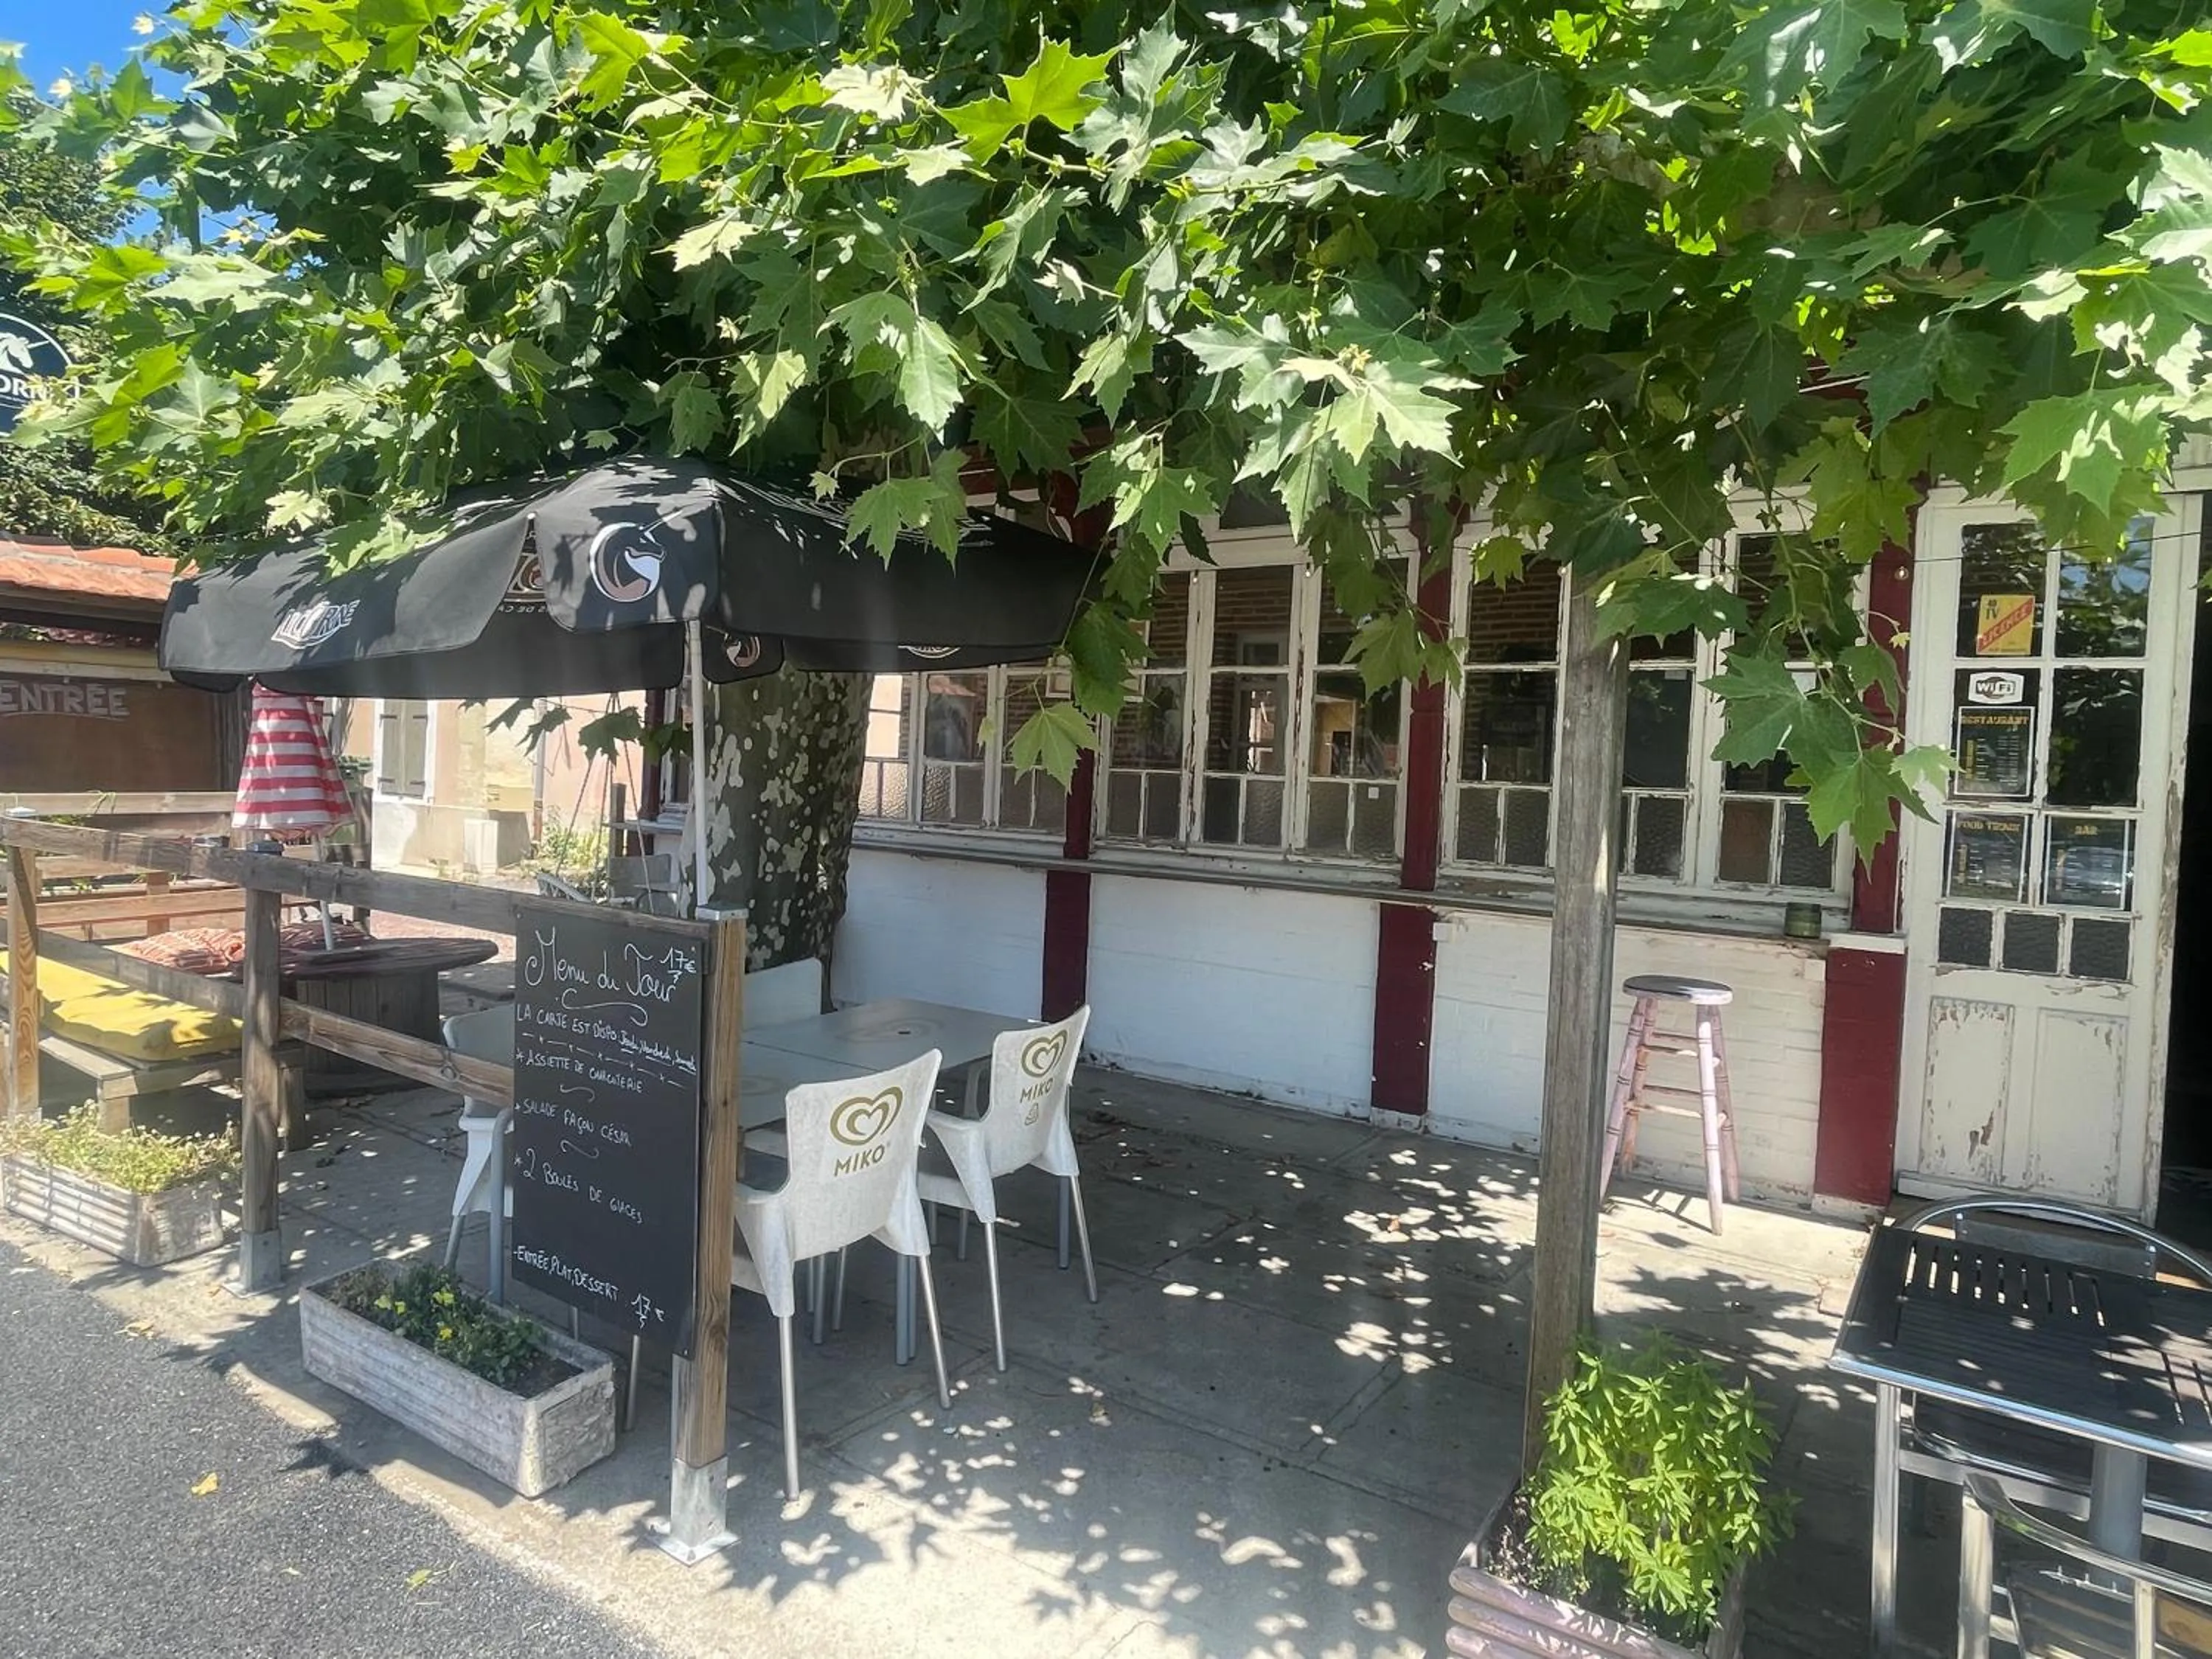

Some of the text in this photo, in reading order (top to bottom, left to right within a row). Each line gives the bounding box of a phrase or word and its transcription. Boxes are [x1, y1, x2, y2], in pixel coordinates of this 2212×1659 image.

[1961, 715, 2029, 726] RESTAURANT
[524, 926, 590, 986] Menu
[597, 950, 620, 990] du
[625, 943, 676, 1003] Jour
[516, 1004, 532, 1021] LA
[536, 1009, 567, 1029] CARTE
[571, 1018, 590, 1034] EST
[526, 1049, 570, 1069] ASSIETTE
[574, 1059, 584, 1074] DE
[1019, 1077, 1054, 1104] MIKO
[523, 1148, 536, 1180] 2
[589, 1185, 602, 1203] DE
[834, 1144, 886, 1178] MIKO
